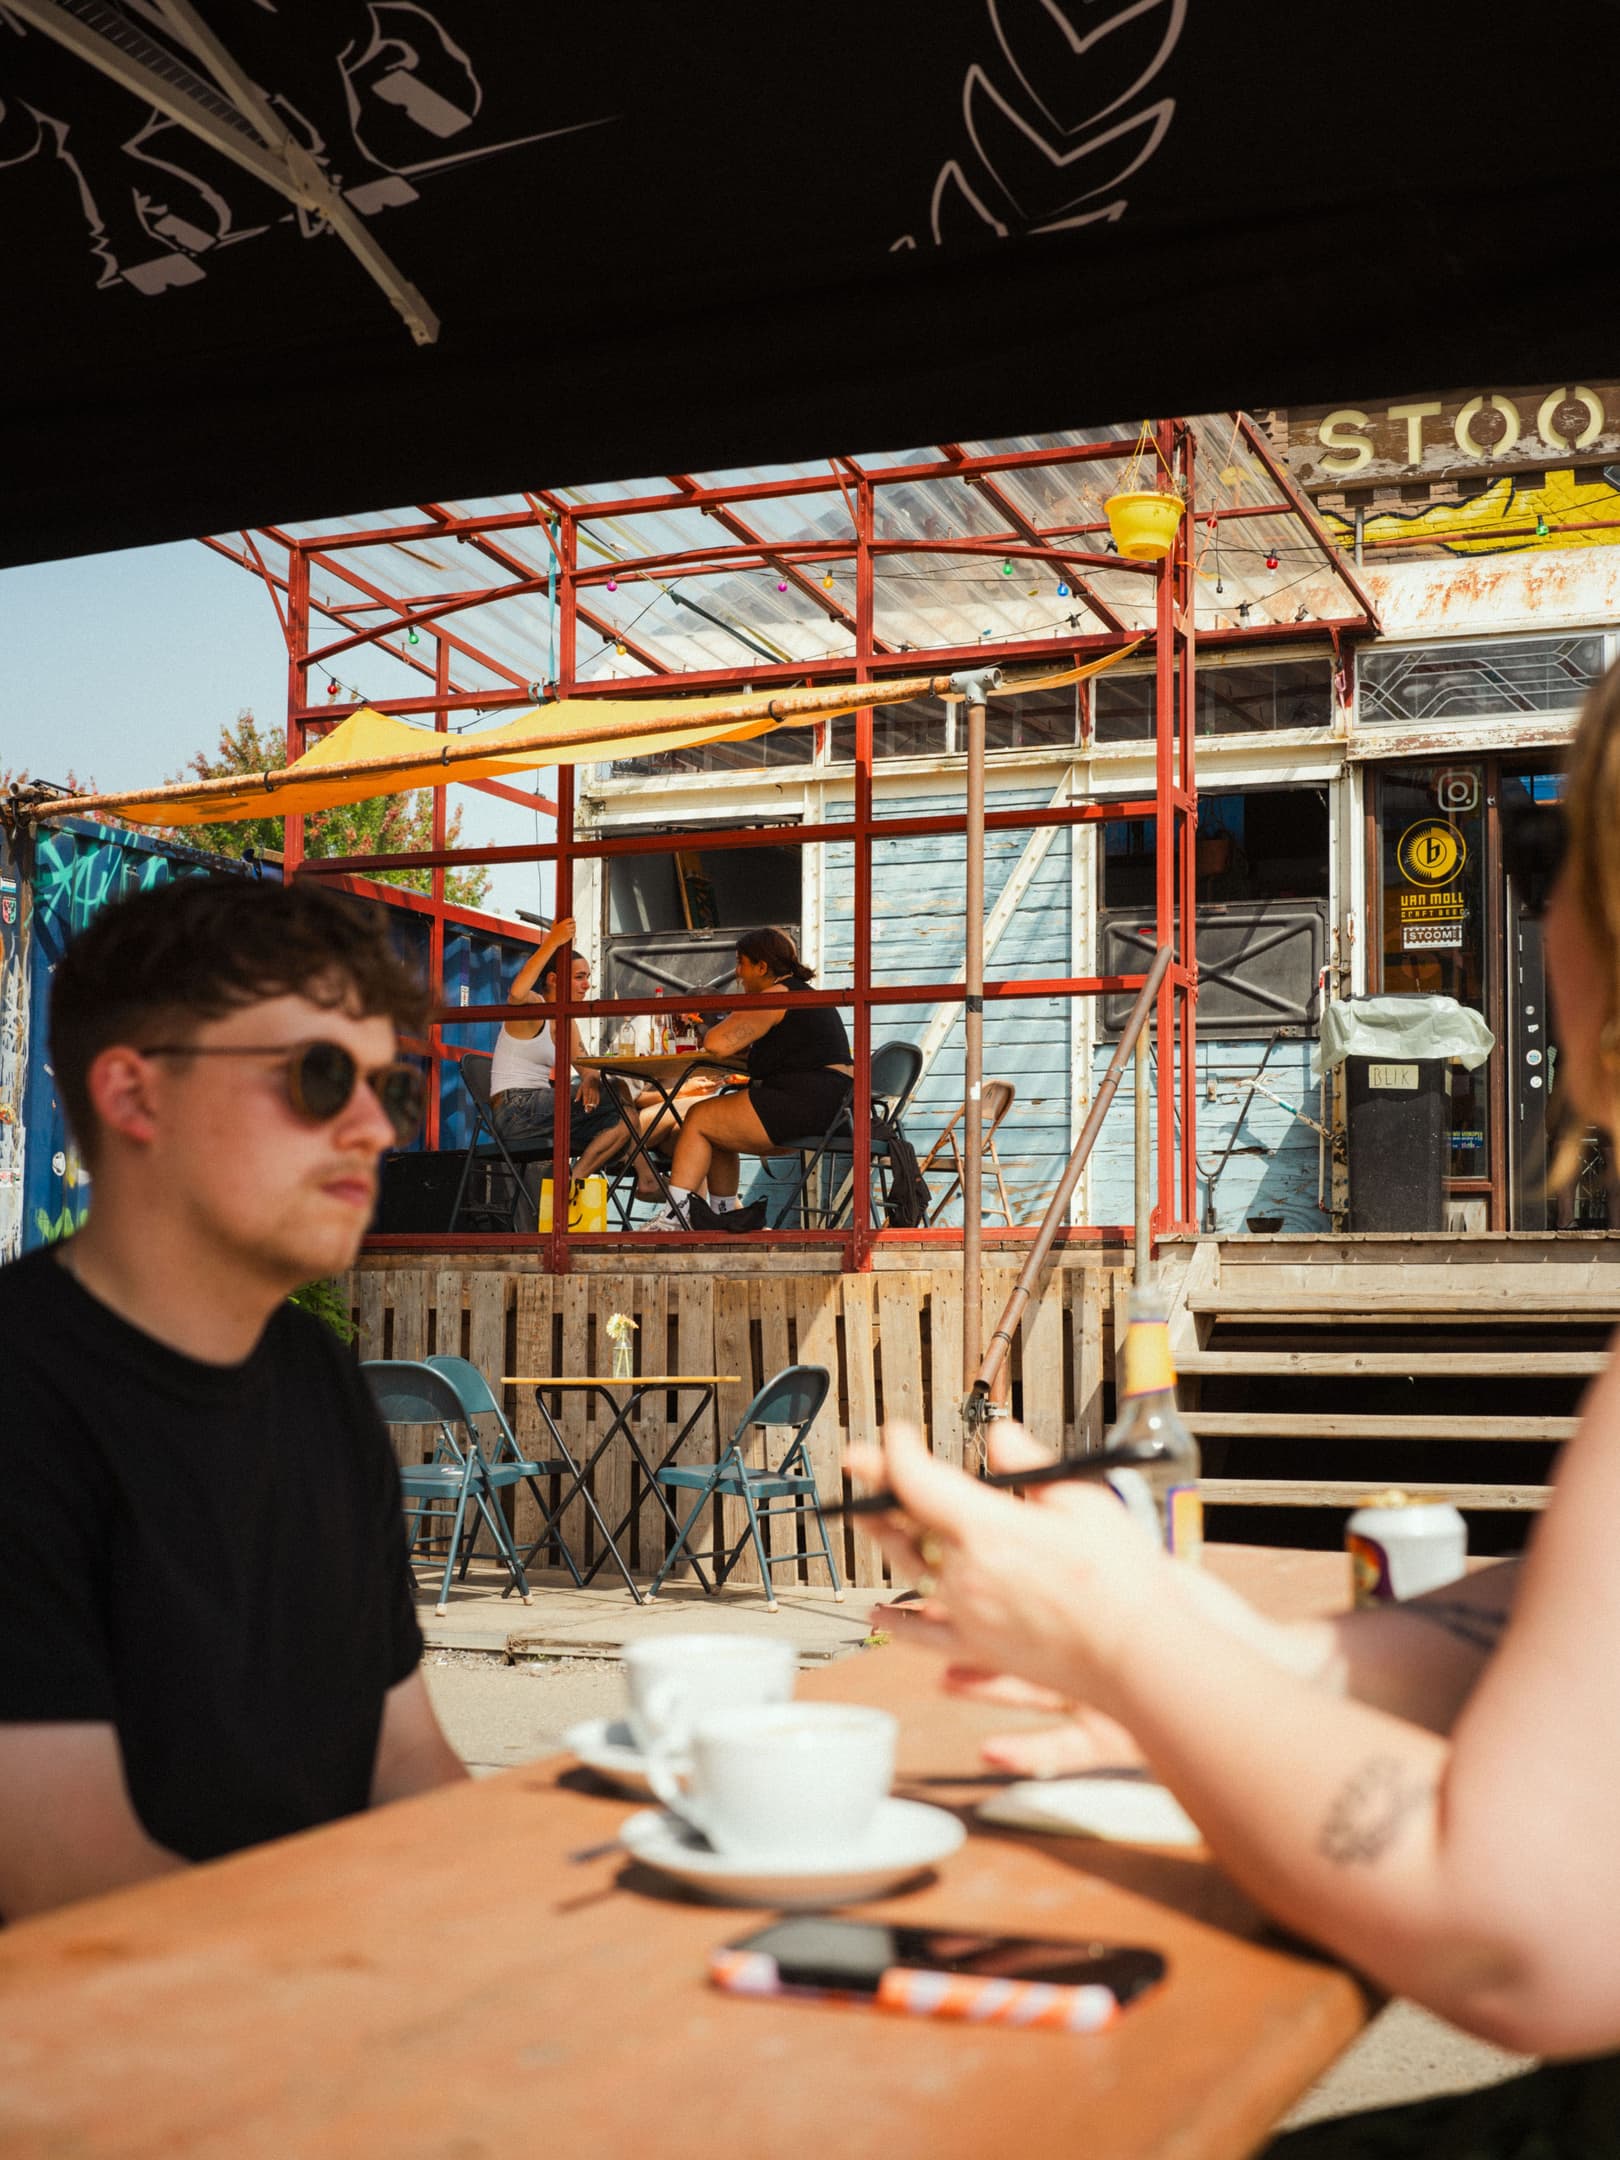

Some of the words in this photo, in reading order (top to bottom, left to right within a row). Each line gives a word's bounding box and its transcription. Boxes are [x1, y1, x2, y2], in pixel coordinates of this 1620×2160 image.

[1319, 386, 1604, 473] STOO
[1401, 894, 1426, 906] VAN
[1430, 892, 1464, 905] MOLL
[1401, 910, 1434, 918] CRAFT
[1409, 930, 1452, 940] STOOM
[1374, 1067, 1410, 1087] BLIK
